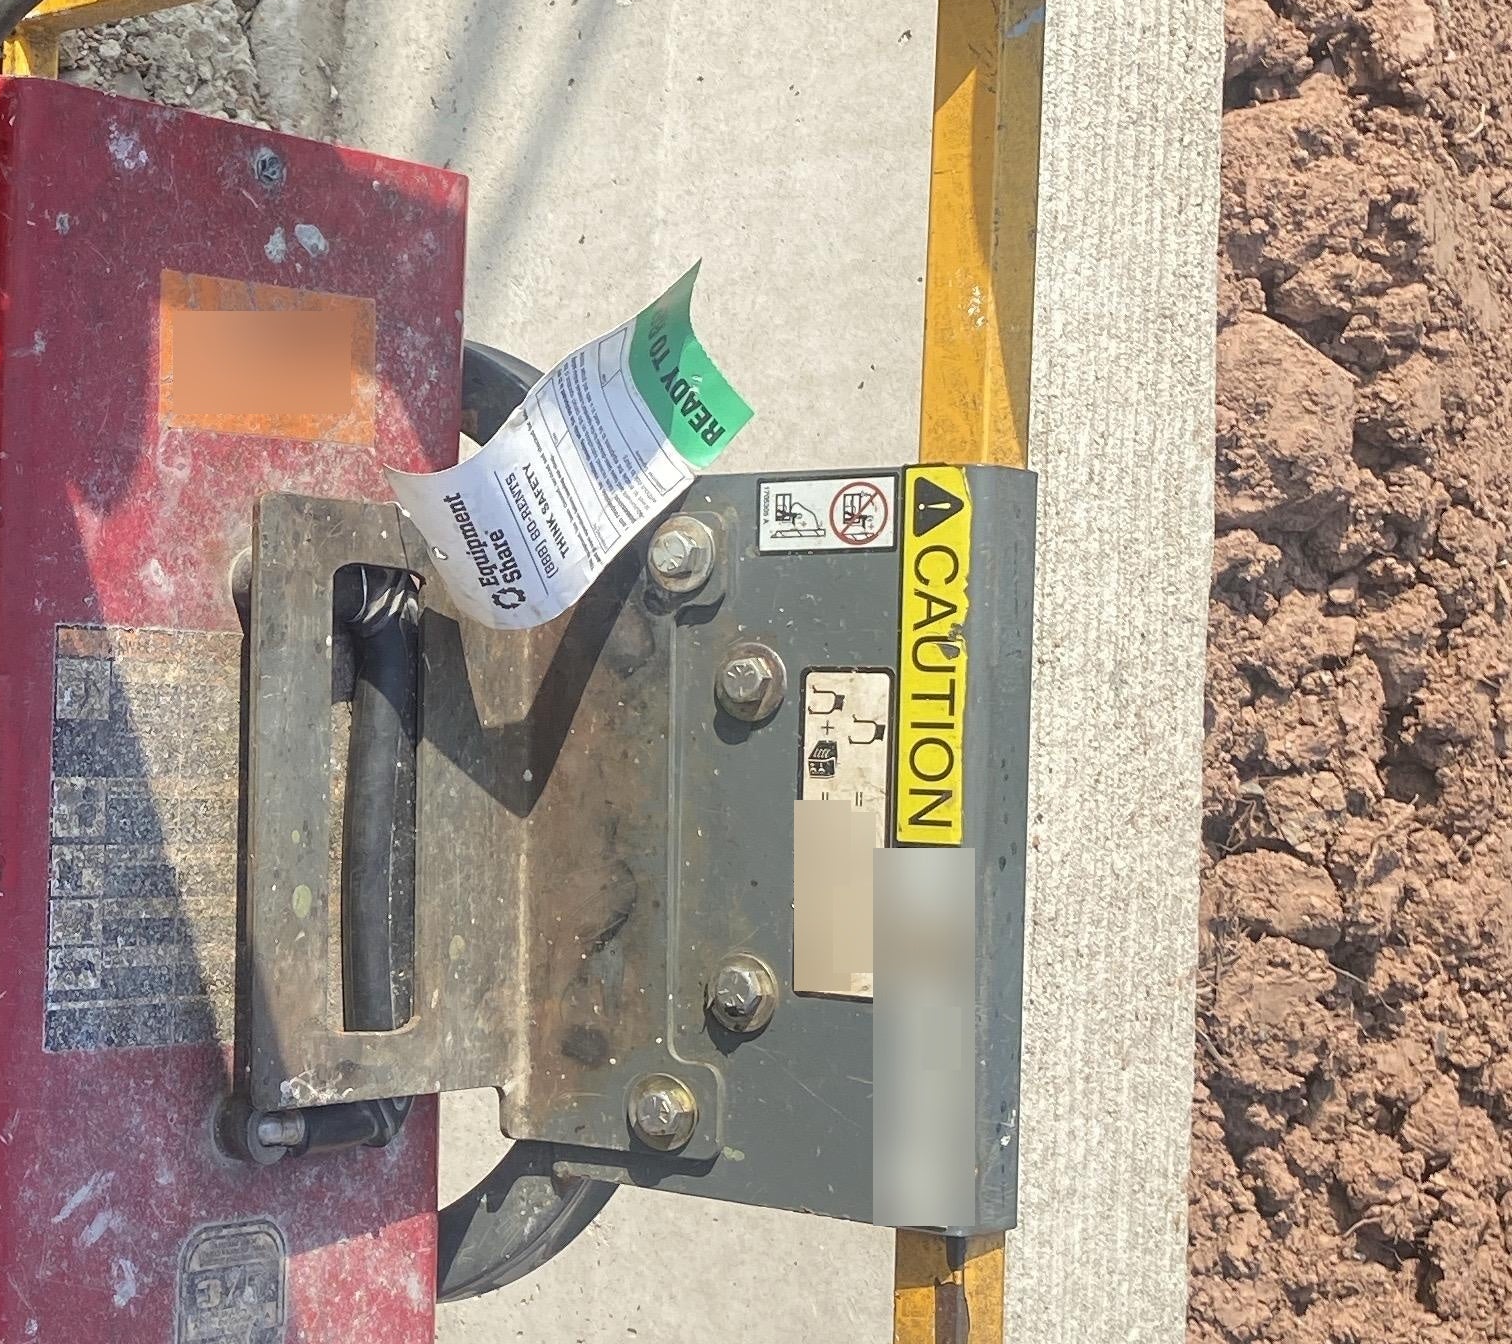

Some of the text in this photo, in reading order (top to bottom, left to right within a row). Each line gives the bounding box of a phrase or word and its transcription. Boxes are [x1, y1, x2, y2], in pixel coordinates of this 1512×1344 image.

[648, 335, 669, 371] TO
[659, 367, 725, 446] READY
[444, 493, 500, 587] Equipment
[490, 529, 520, 580] Share
[505, 473, 558, 579] (888) 80-RENTS
[522, 462, 569, 559] THINK SAFETY
[908, 545, 960, 827] CAUTION
